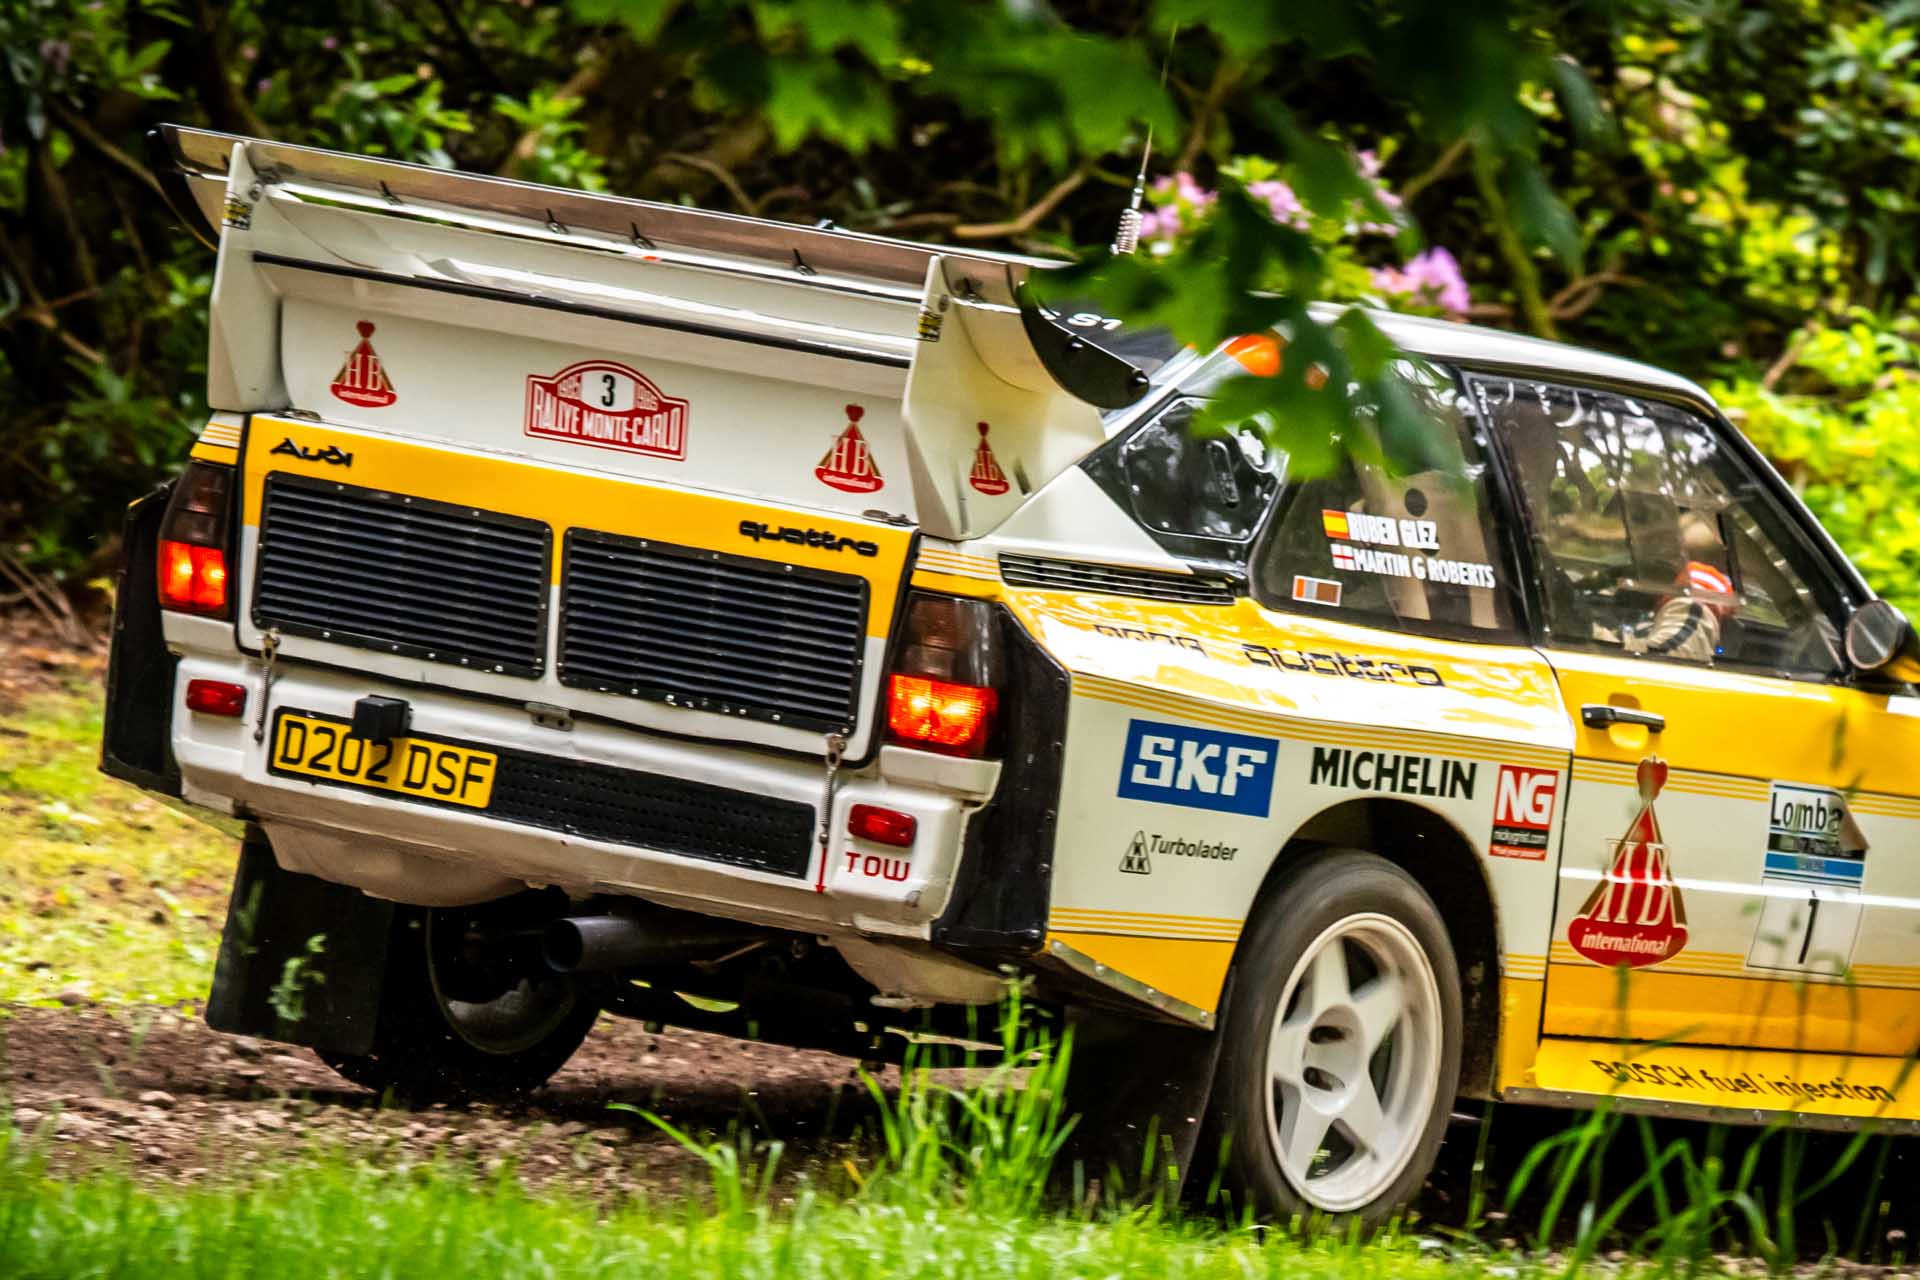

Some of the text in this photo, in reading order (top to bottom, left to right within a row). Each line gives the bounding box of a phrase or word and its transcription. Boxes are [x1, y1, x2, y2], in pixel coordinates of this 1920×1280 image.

[601, 374, 616, 407] 3
[533, 383, 681, 451] RALLYE MONTE-CARLO
[739, 520, 879, 557] quattro
[1353, 549, 1496, 589] MARTIN G ROBERTS
[280, 720, 491, 799] D202 DSF
[1131, 735, 1268, 796] SKF
[1310, 747, 1477, 800] MICHELIN
[1495, 769, 1555, 825] NG
[846, 852, 910, 881] TOW
[1150, 834, 1239, 861] Turbolader
[1581, 928, 1672, 956] international
[1699, 1069, 1767, 1094] fuel
[1758, 1073, 1896, 1102] injection
